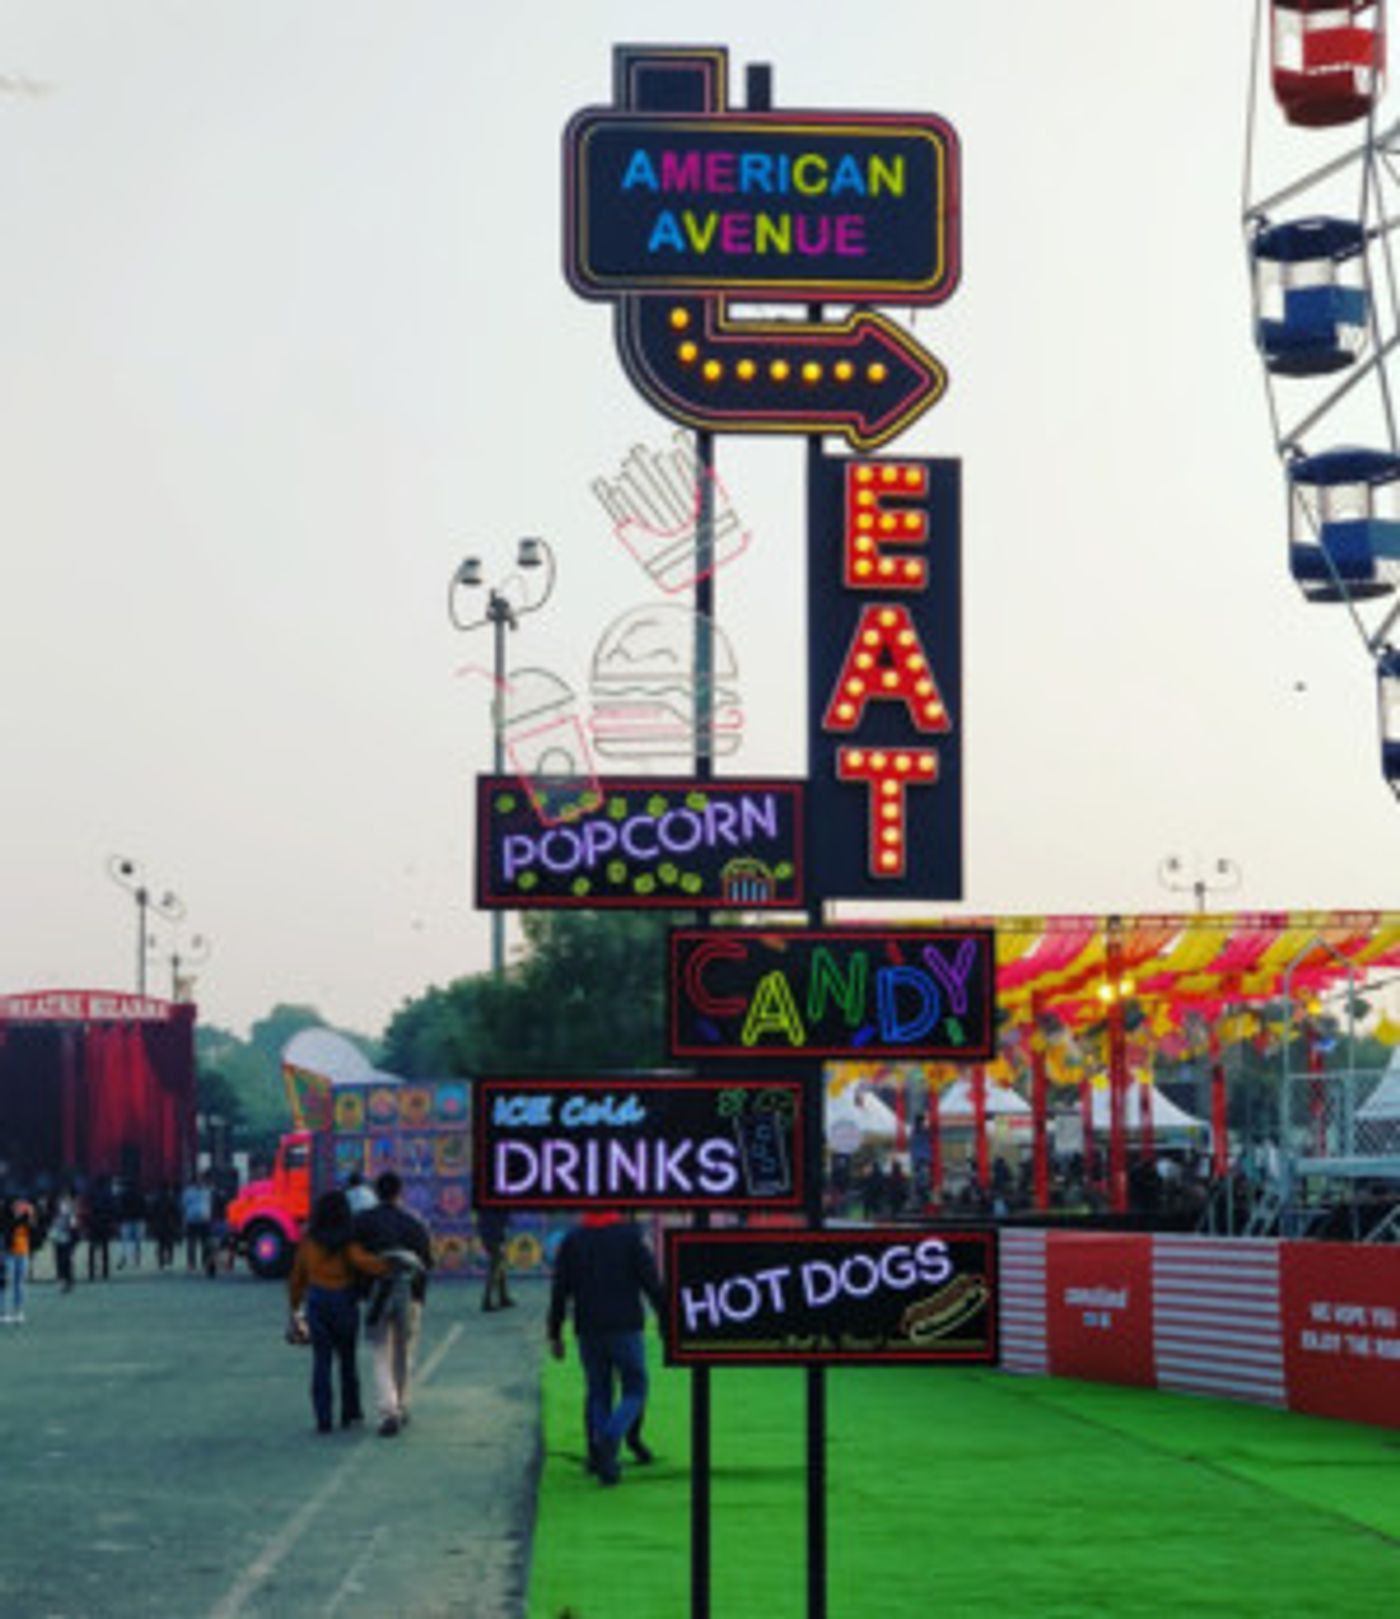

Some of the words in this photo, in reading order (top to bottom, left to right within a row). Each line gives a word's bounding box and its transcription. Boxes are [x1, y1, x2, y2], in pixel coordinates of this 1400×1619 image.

[621, 149, 904, 197] AMERICAN
[647, 209, 867, 256] AVENUE
[821, 462, 951, 878] EAT
[502, 794, 778, 880] POPCORN
[685, 939, 977, 1047] CANDY
[559, 1094, 646, 1126] Cold
[494, 1137, 738, 1195] DRINKS
[681, 1267, 791, 1332] HOT
[801, 1238, 953, 1308] DOGS
